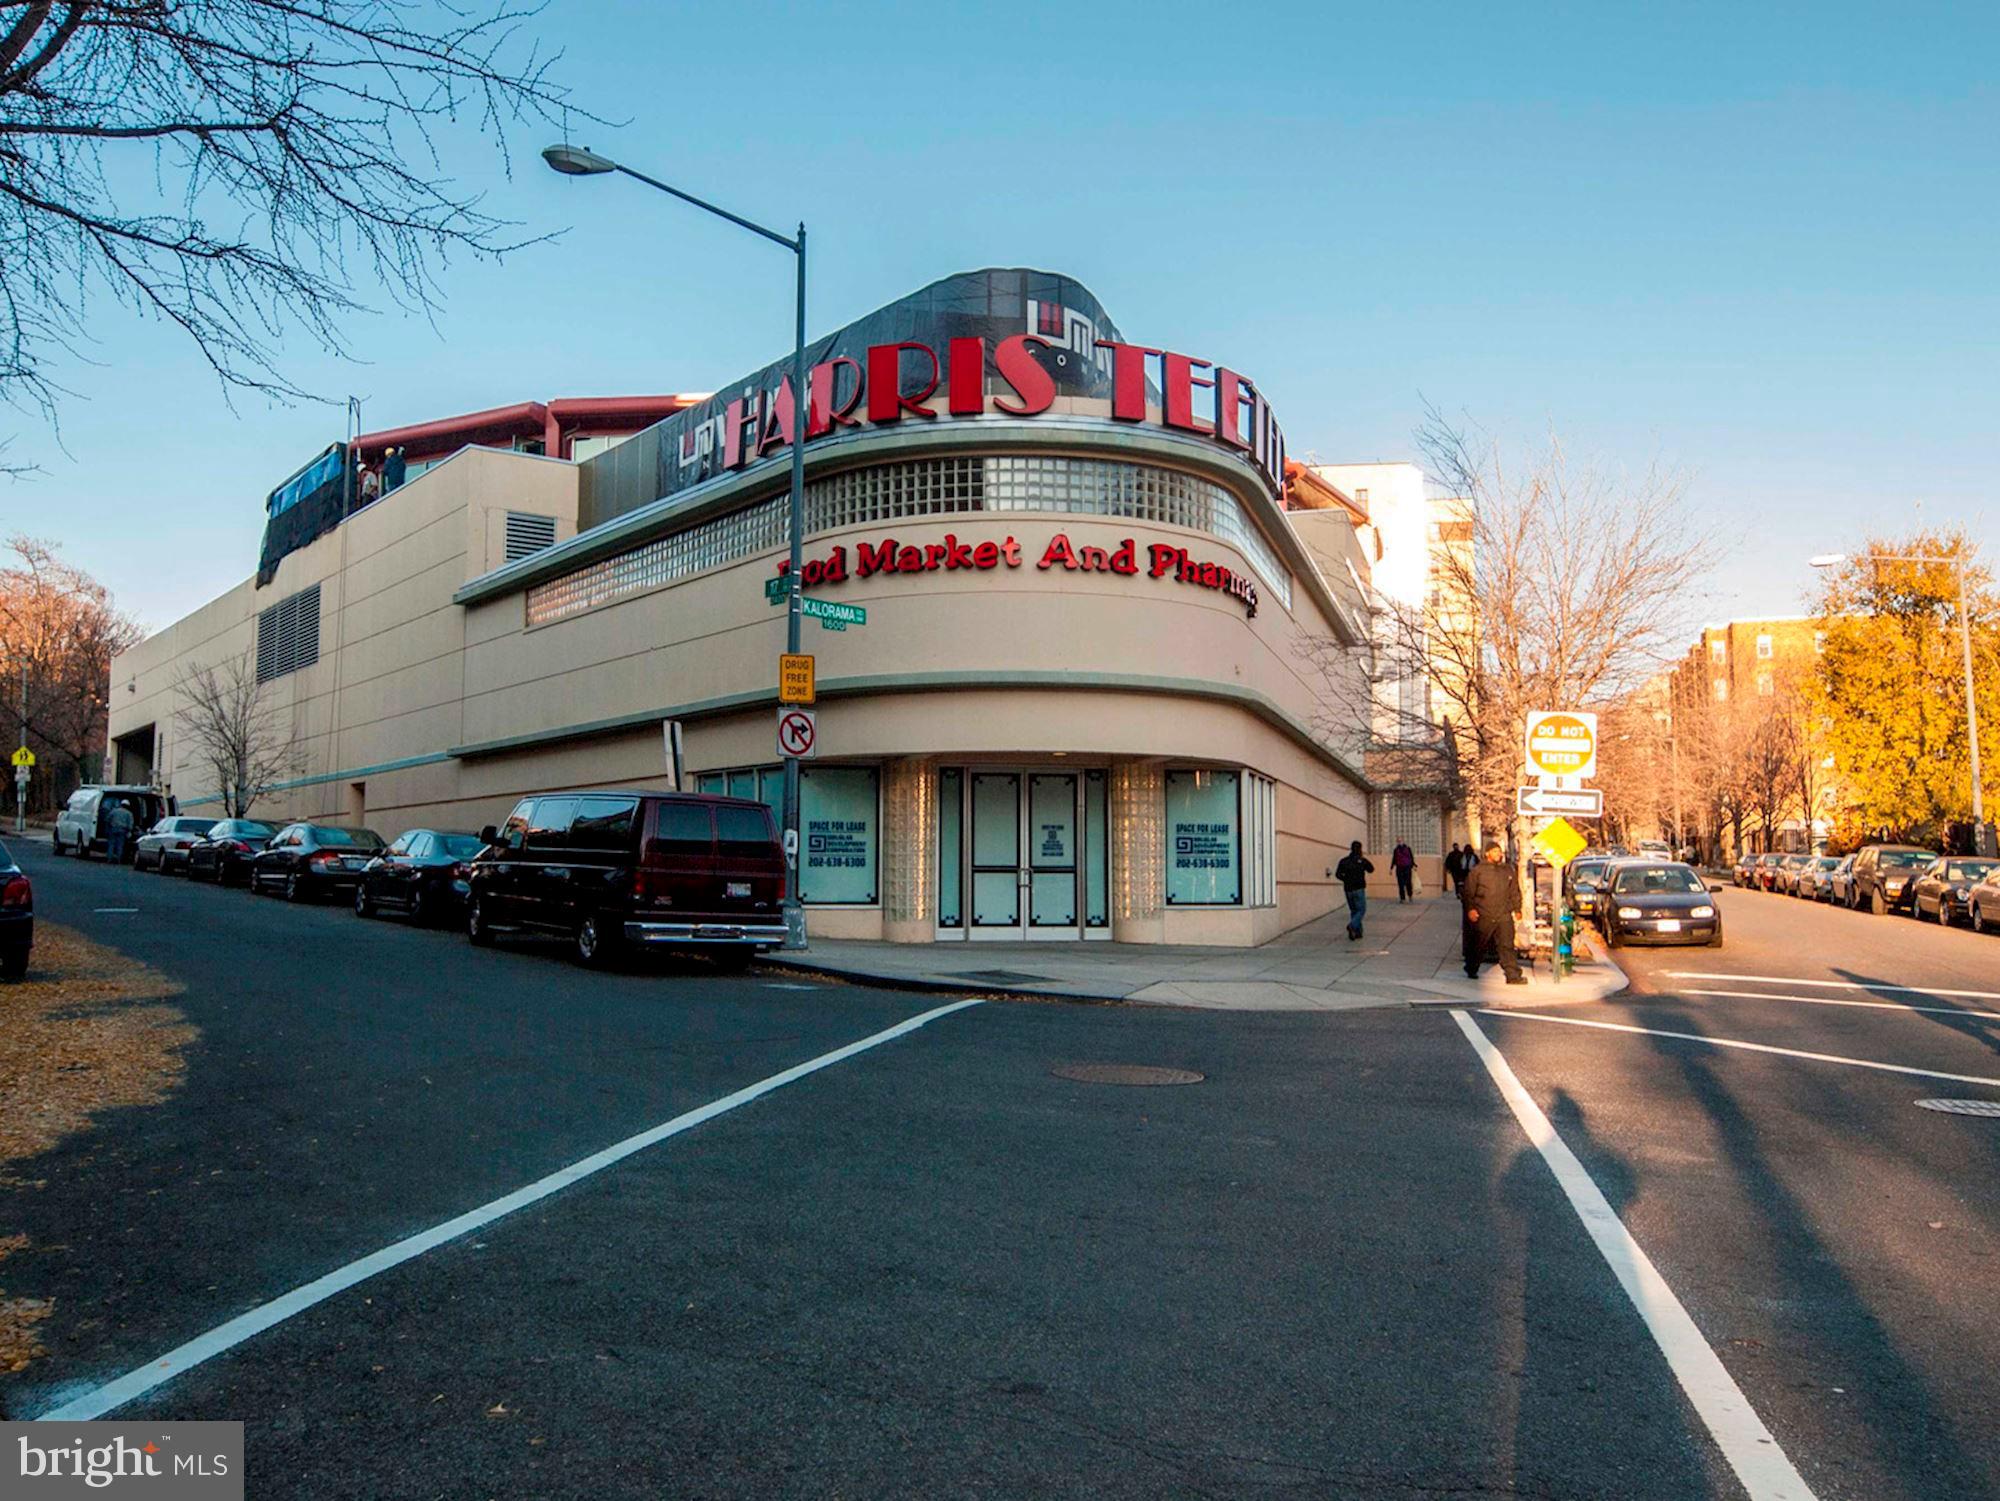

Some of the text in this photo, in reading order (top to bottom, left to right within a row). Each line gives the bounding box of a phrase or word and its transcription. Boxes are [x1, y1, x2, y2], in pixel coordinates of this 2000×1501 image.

[723, 334, 1057, 470] HARRIS
[855, 533, 1021, 578] Market
[1036, 533, 1139, 576] And
[803, 600, 856, 622] KALORAMA
[824, 619, 845, 630] 1600
[785, 660, 809, 670] DRUG
[786, 673, 808, 683] FREE
[787, 686, 808, 696] ZONE
[1538, 725, 1585, 738] DO NOT
[1541, 752, 1581, 766] ENTER
[809, 821, 866, 832] SPACE FOR LEASE
[1176, 824, 1230, 833] SPACE FOR LEASE
